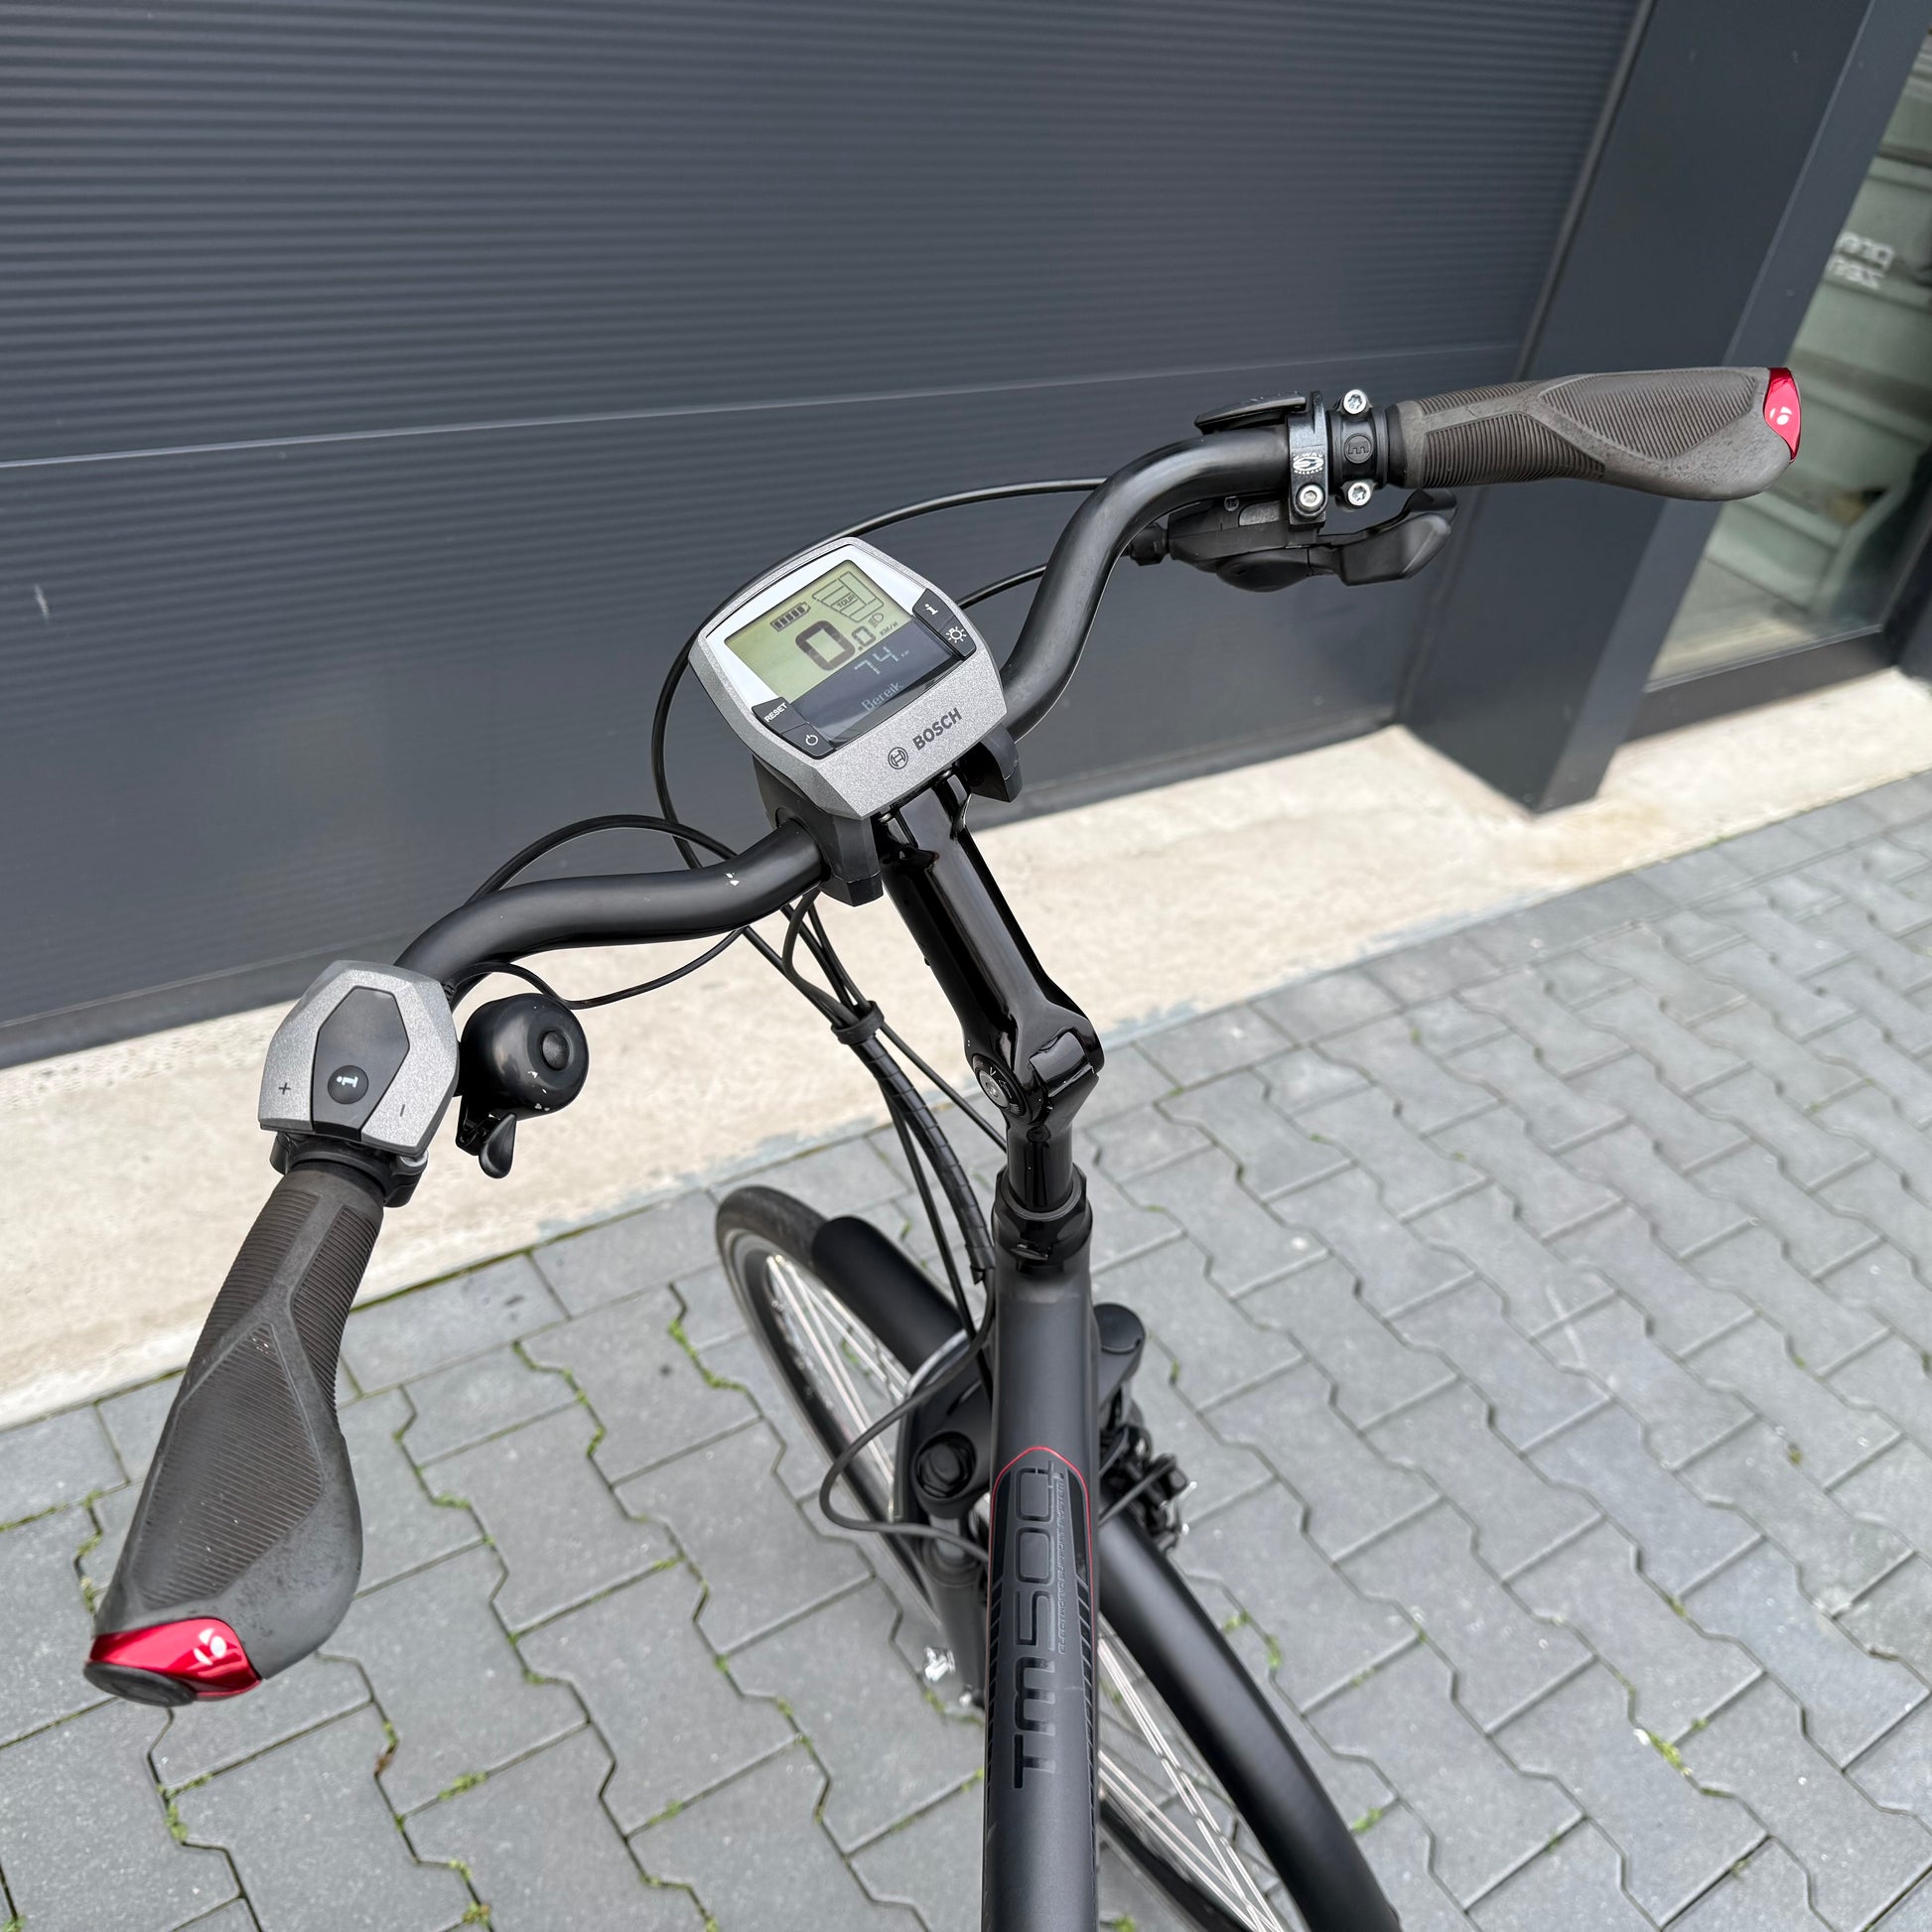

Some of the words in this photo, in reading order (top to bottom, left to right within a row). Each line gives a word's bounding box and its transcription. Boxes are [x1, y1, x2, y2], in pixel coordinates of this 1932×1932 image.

[836, 593, 857, 609] TOUR
[854, 646, 899, 675] 74
[861, 682, 903, 712] Bereik
[763, 702, 788, 723] RESET
[912, 707, 962, 751] BOSCH
